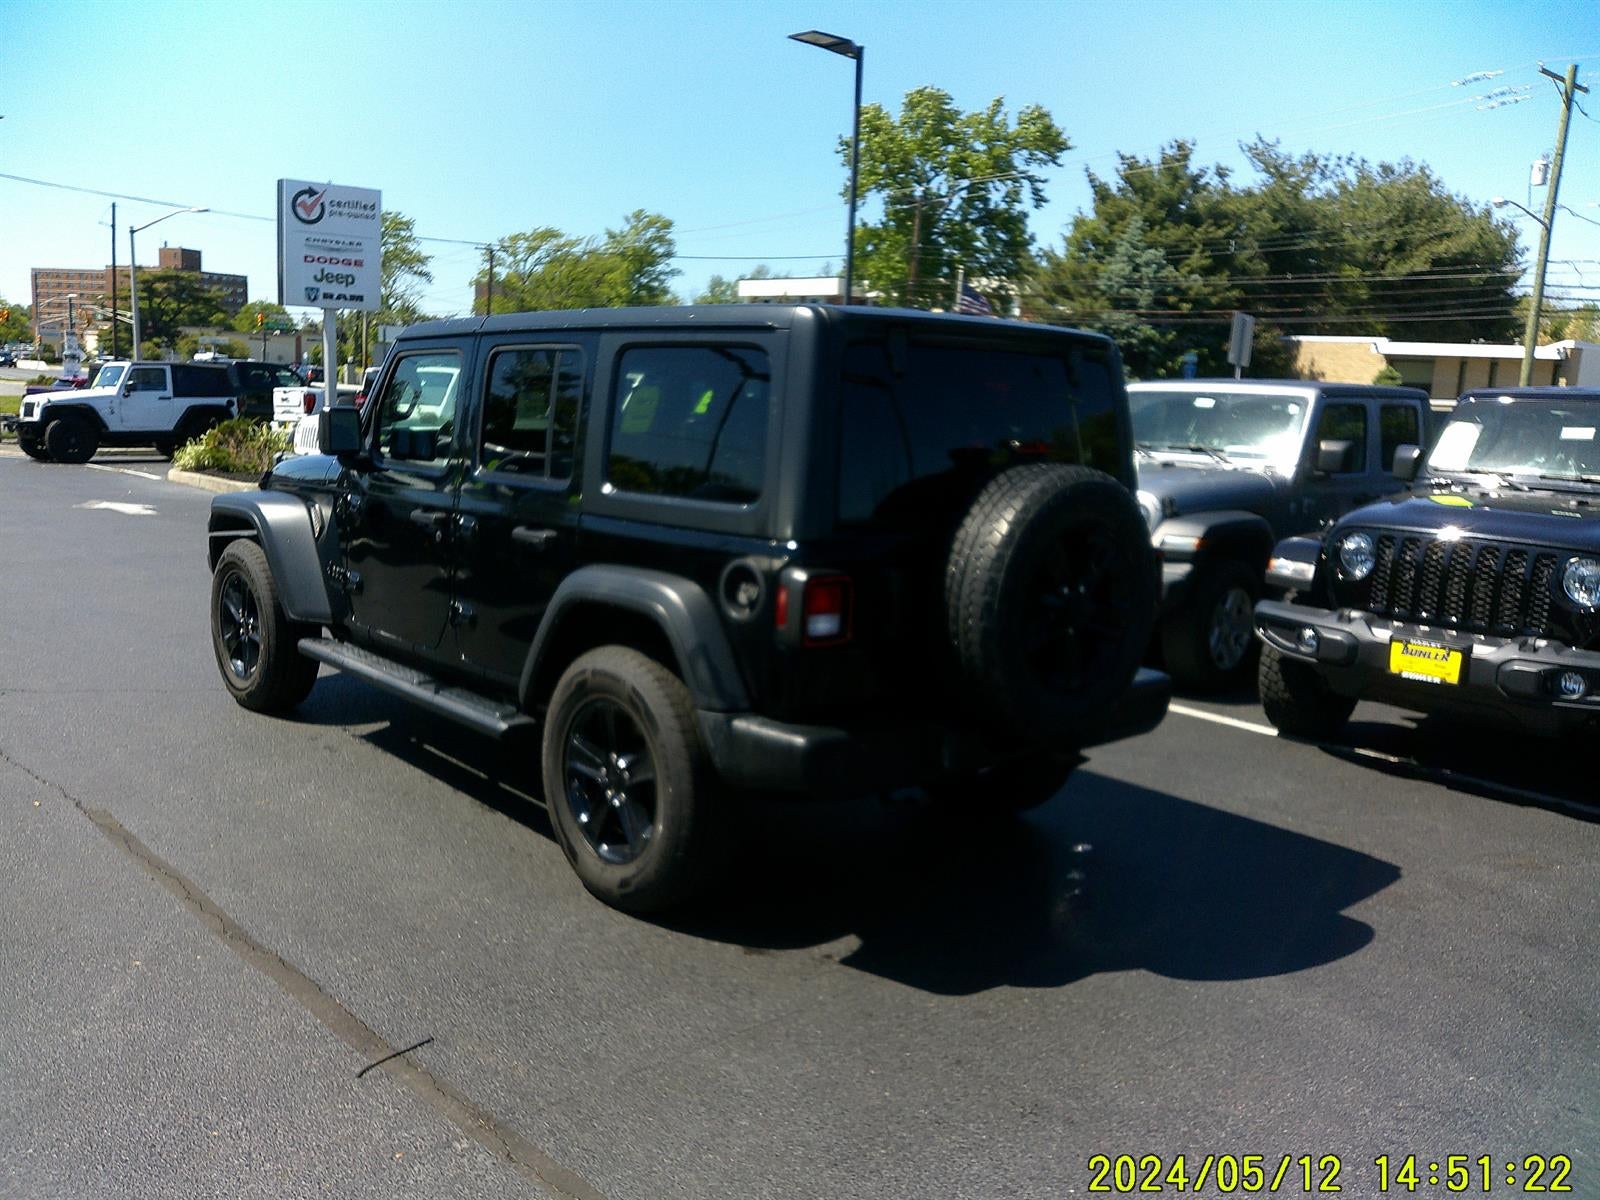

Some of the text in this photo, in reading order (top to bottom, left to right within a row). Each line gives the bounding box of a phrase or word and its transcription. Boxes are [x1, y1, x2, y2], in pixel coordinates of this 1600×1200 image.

[329, 199, 376, 212] certified
[328, 209, 376, 220] pre-owned
[305, 236, 362, 246] CHRYSLER
[303, 254, 364, 268] DODGE
[313, 267, 356, 287] Jeep
[322, 291, 364, 302] RAM
